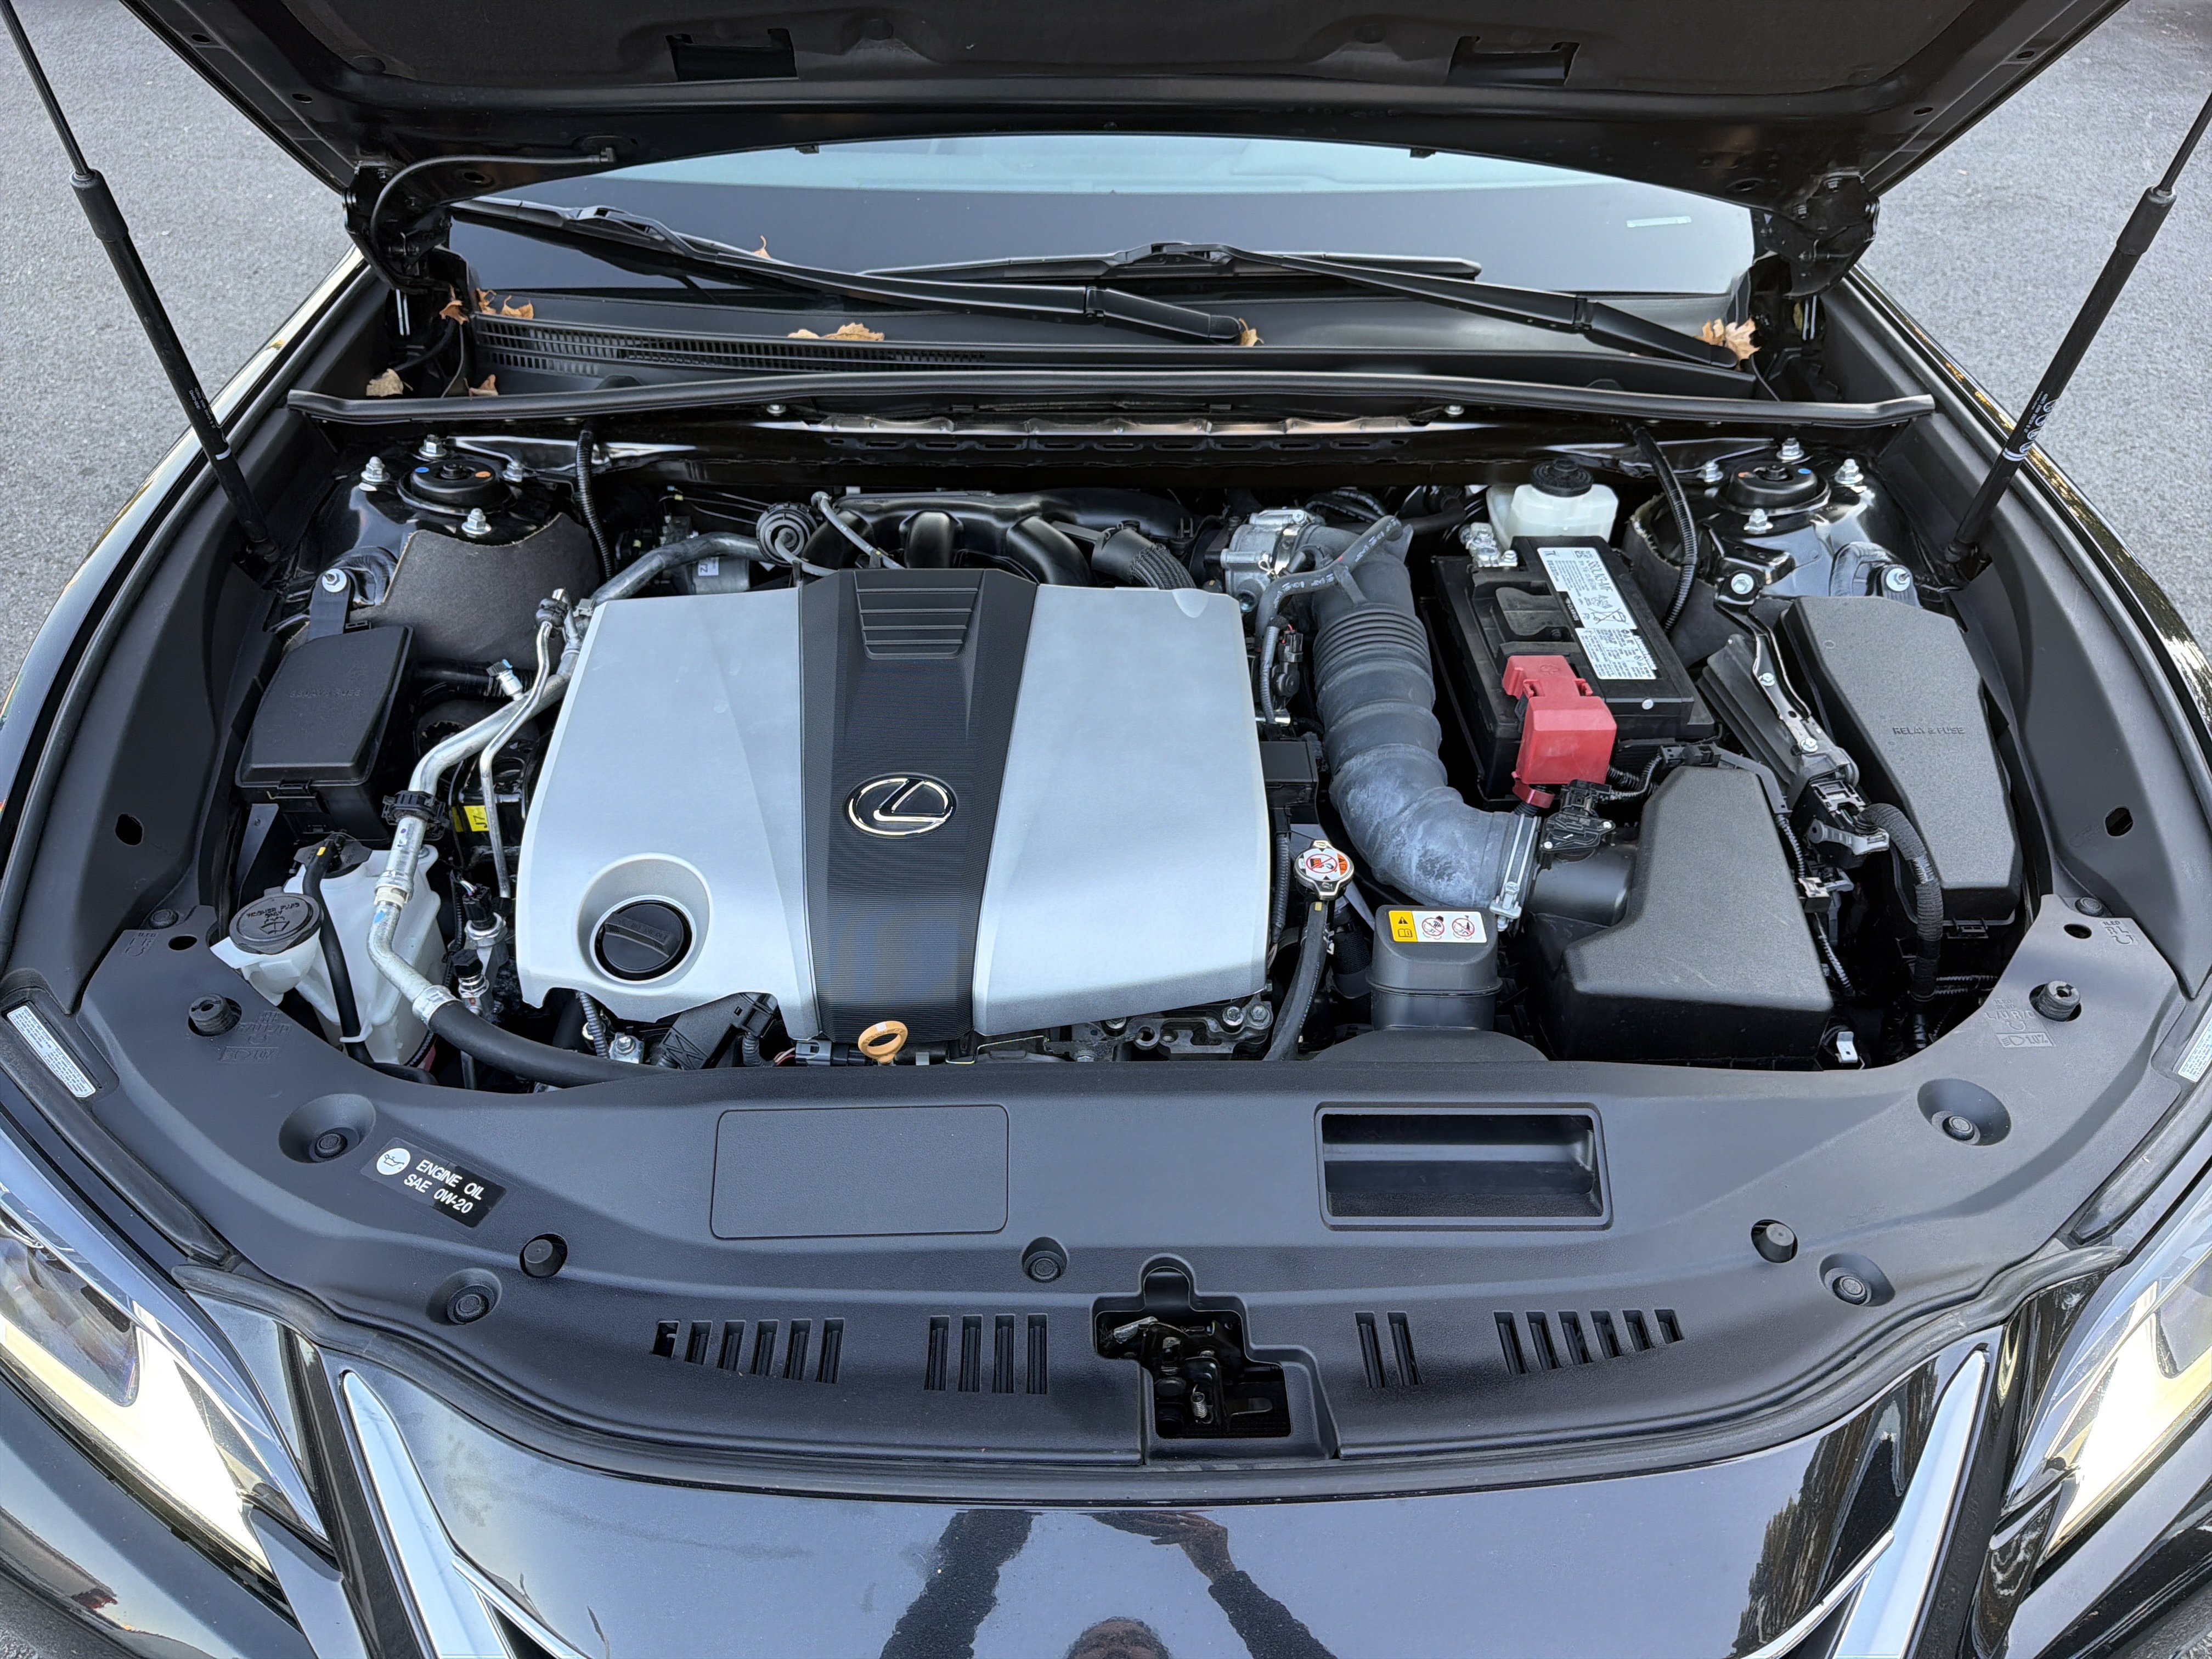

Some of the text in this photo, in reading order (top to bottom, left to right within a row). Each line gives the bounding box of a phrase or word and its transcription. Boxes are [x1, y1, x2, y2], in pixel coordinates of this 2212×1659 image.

[1893, 726, 1926, 735] RELAY
[1937, 726, 1965, 735] FUSE
[404, 1173, 473, 1214] SAE 0W-20
[415, 1159, 484, 1200] ENGINE OIL
